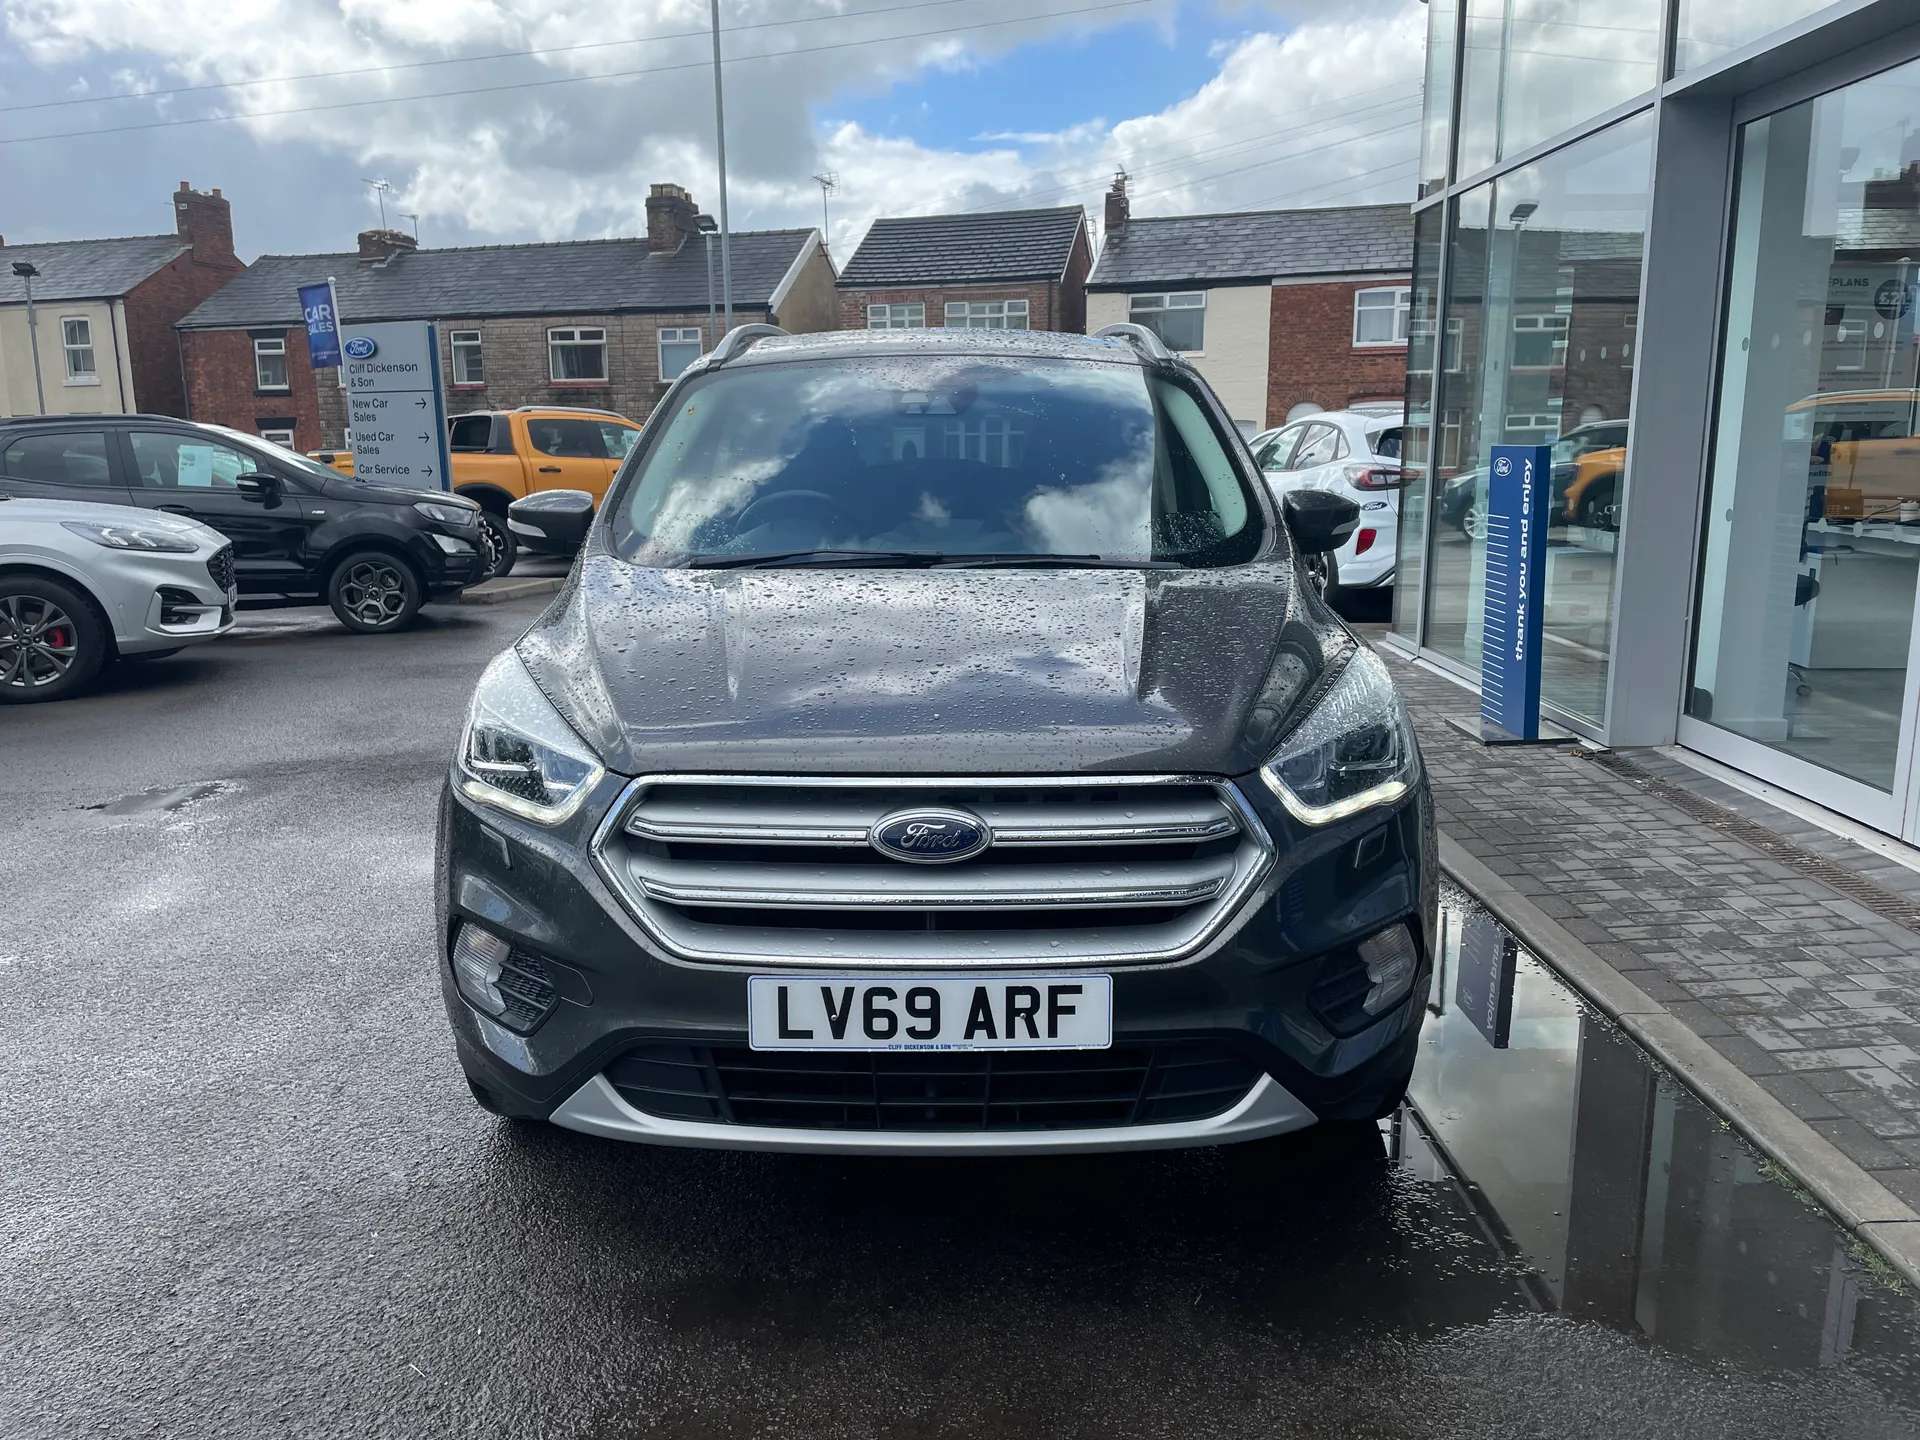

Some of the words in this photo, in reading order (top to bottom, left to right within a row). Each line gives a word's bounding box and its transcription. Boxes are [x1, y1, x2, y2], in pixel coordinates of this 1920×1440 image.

[305, 304, 332, 323] CAR
[349, 340, 370, 354] Ford
[349, 363, 365, 374] Cliff
[366, 362, 418, 374] Dickenson
[350, 378, 357, 387] &
[357, 377, 375, 387] Son
[352, 399, 370, 409] New
[372, 399, 388, 409] Car
[354, 412, 377, 422] Sales
[356, 432, 377, 442] Used
[378, 431, 395, 441] Car
[357, 445, 380, 455] Sales
[359, 464, 373, 474] Car
[374, 464, 410, 474] Service
[1522, 458, 1533, 514] enjoy
[1519, 519, 1529, 558] and
[1518, 562, 1527, 600] you
[1515, 603, 1525, 662] thank
[900, 822, 961, 848] Ford
[777, 985, 941, 1040] LV69
[963, 984, 1083, 1040] ARF
